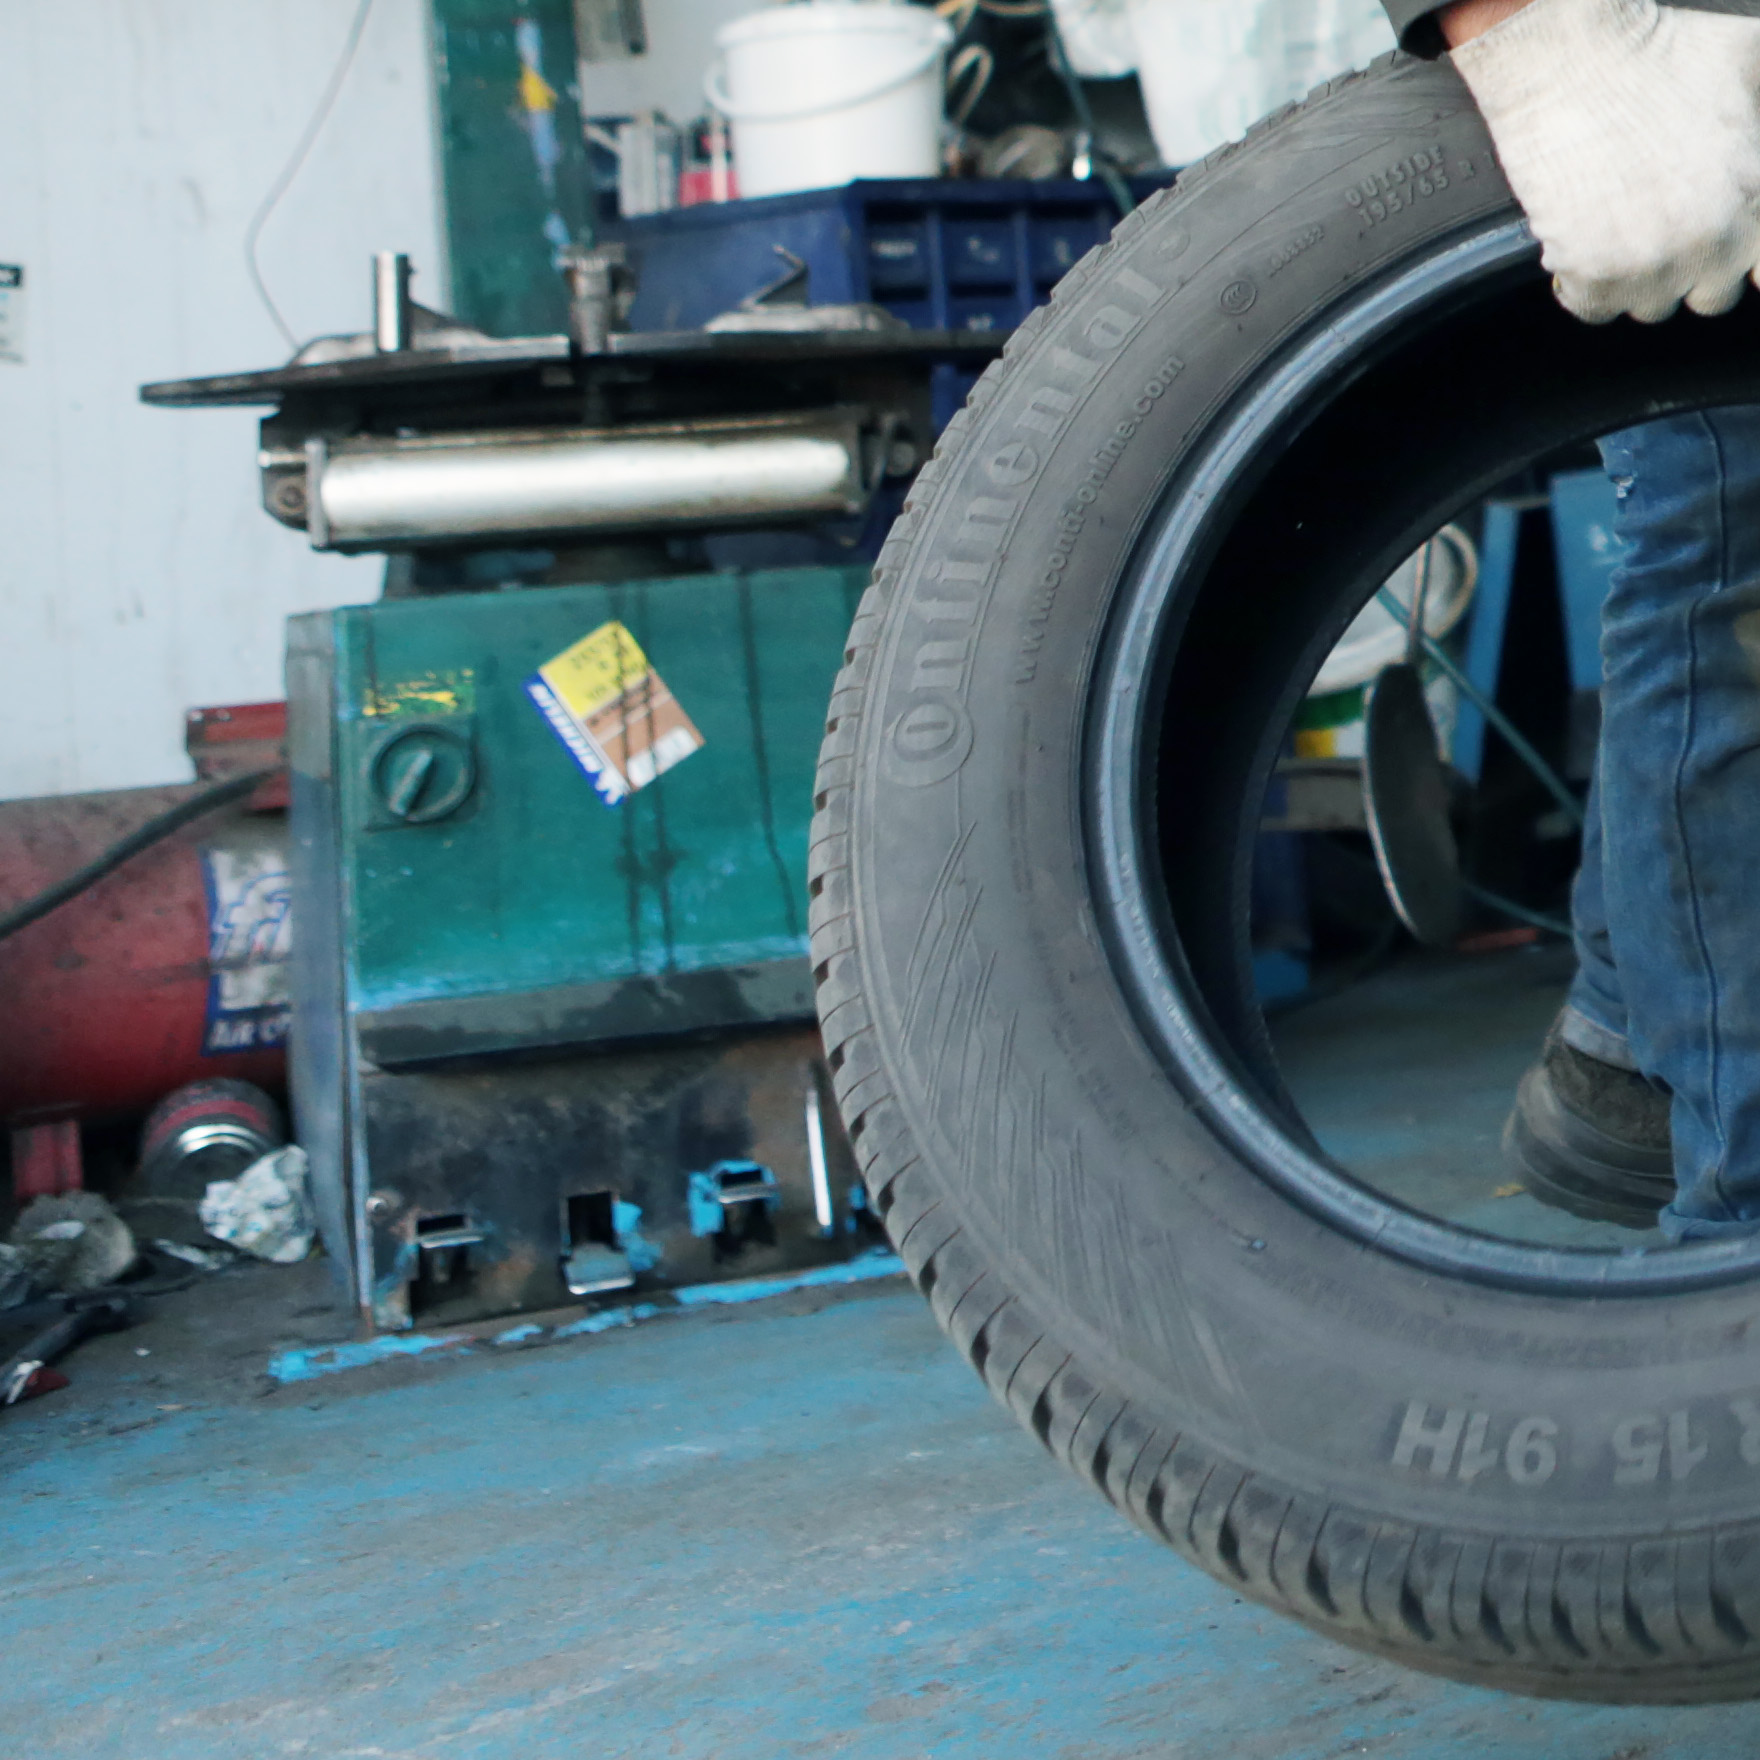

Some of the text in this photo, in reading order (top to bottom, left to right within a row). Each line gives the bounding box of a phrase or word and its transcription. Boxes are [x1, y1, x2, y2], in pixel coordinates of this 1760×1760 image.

[1344, 144, 1446, 208] OUTSIDE
[1355, 168, 1451, 231] 195/65
[1391, 1396, 1560, 1485] 91H
[1611, 1410, 1711, 1488] 15
